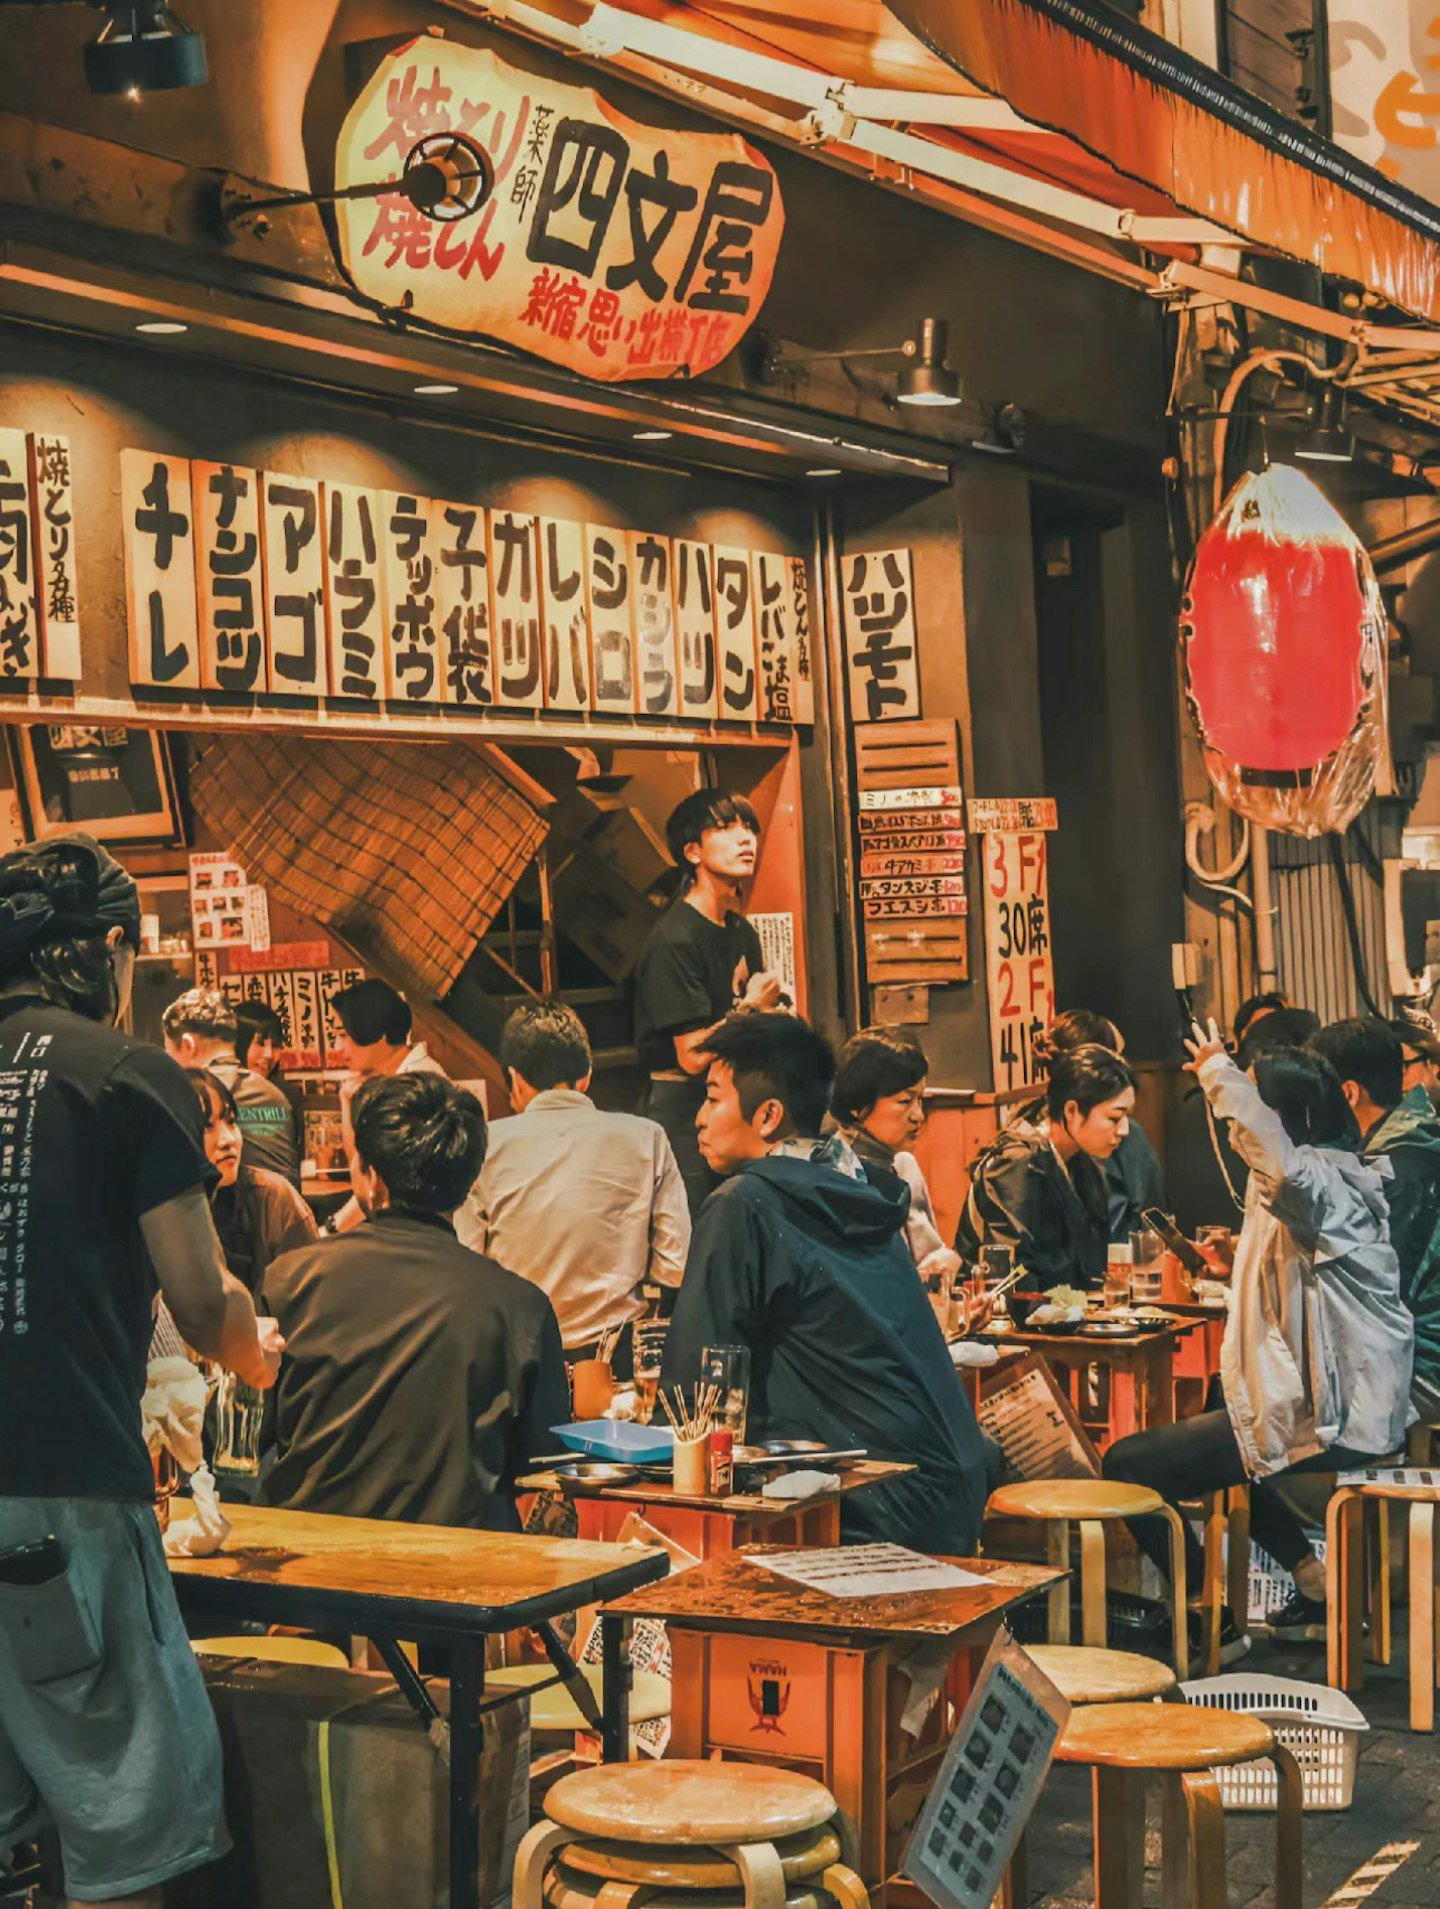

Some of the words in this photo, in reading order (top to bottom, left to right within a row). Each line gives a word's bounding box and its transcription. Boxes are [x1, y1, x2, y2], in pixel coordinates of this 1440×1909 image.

[510, 105, 554, 223] 薬師
[526, 117, 772, 315] 四文屋
[518, 266, 731, 364] 新宿思い出横丁店
[136, 462, 188, 681] チレ
[209, 465, 261, 689] ナンコツ
[268, 484, 323, 682] アゴ
[329, 490, 376, 696] ハラミ
[391, 496, 436, 698] テッポウ
[441, 507, 492, 703] 子袋
[494, 513, 539, 699] ガツ
[592, 537, 631, 700] シロ
[637, 537, 673, 713] カシラ
[680, 544, 713, 703] ハツ
[717, 557, 754, 712] タン
[847, 554, 912, 718] ハツモト
[990, 836, 1035, 898] 3F
[998, 893, 1048, 959] 30席
[998, 958, 1045, 1017] 2F
